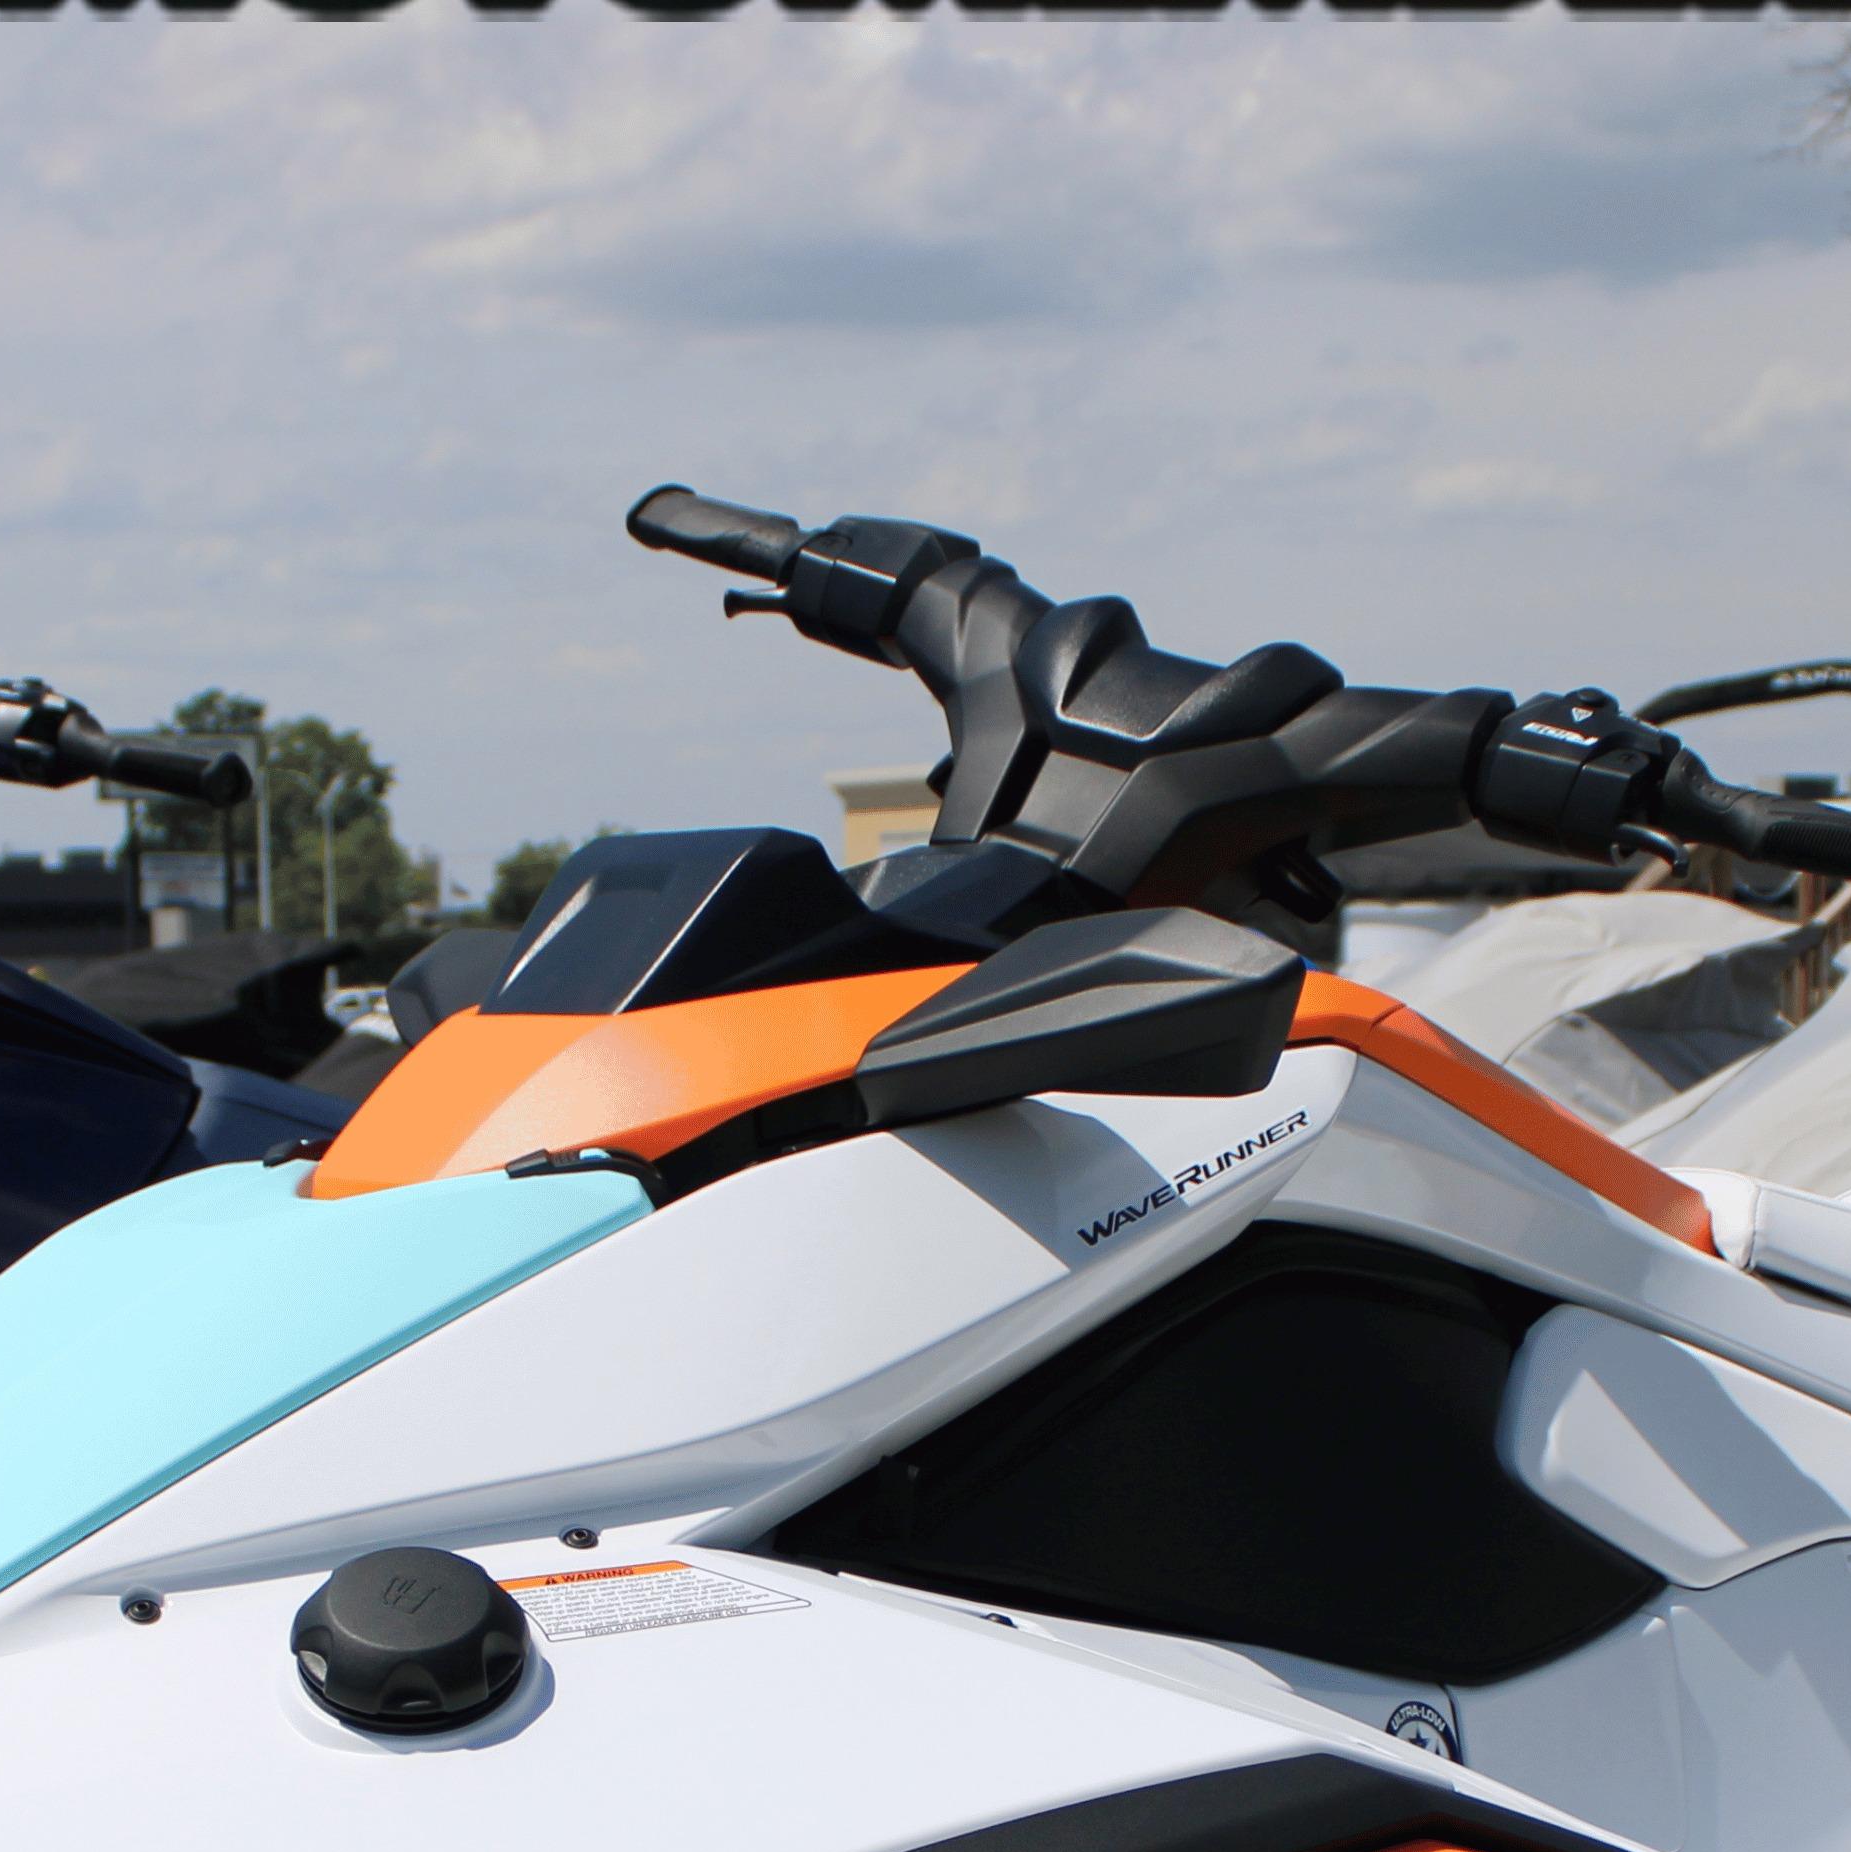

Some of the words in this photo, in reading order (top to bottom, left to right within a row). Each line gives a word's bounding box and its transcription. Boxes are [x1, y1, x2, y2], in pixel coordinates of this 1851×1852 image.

[1076, 1109, 1310, 1247] WAVERUNNER
[563, 1567, 634, 1583] WARNING
[1391, 1703, 1446, 1732] ULTRA-LOW
